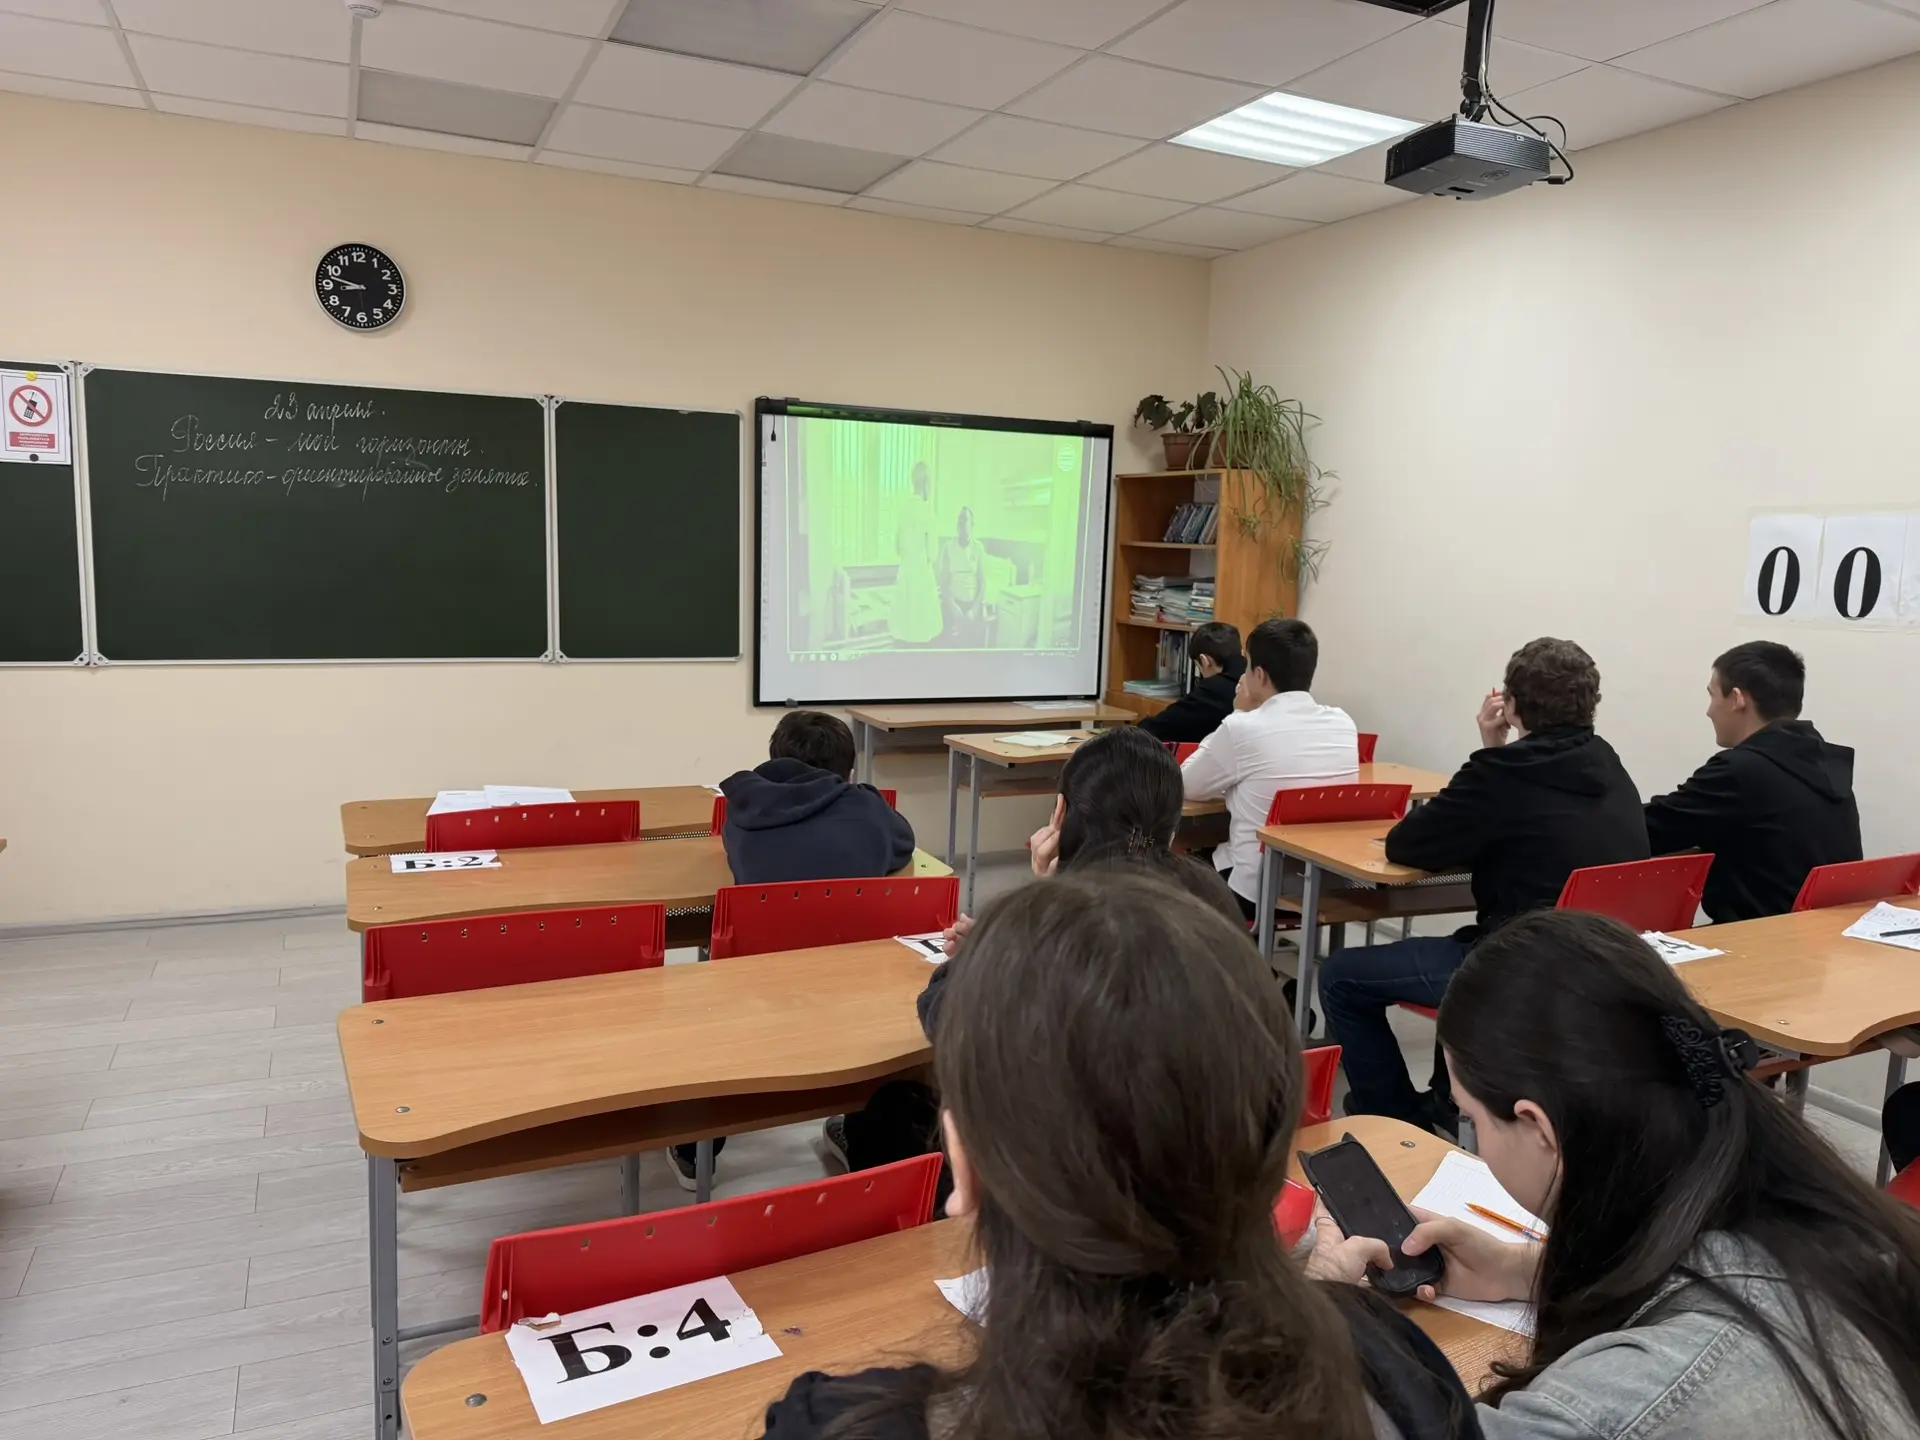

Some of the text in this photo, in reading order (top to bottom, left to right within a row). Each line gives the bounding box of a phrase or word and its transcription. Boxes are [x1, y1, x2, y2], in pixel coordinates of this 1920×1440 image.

[338, 255, 349, 266] 11
[351, 252, 367, 263] 12
[372, 258, 378, 268] 1
[326, 265, 341, 277] 10
[381, 270, 392, 280] 2
[322, 279, 334, 290] 9
[388, 284, 397, 295] 3
[329, 295, 340, 306] 8
[383, 299, 393, 310] 4
[341, 306, 351, 317] 7
[373, 308, 383, 319] 5
[356, 312, 368, 323] 6
[264, 392, 298, 420] 23
[537, 1297, 732, 1384] Б:4
